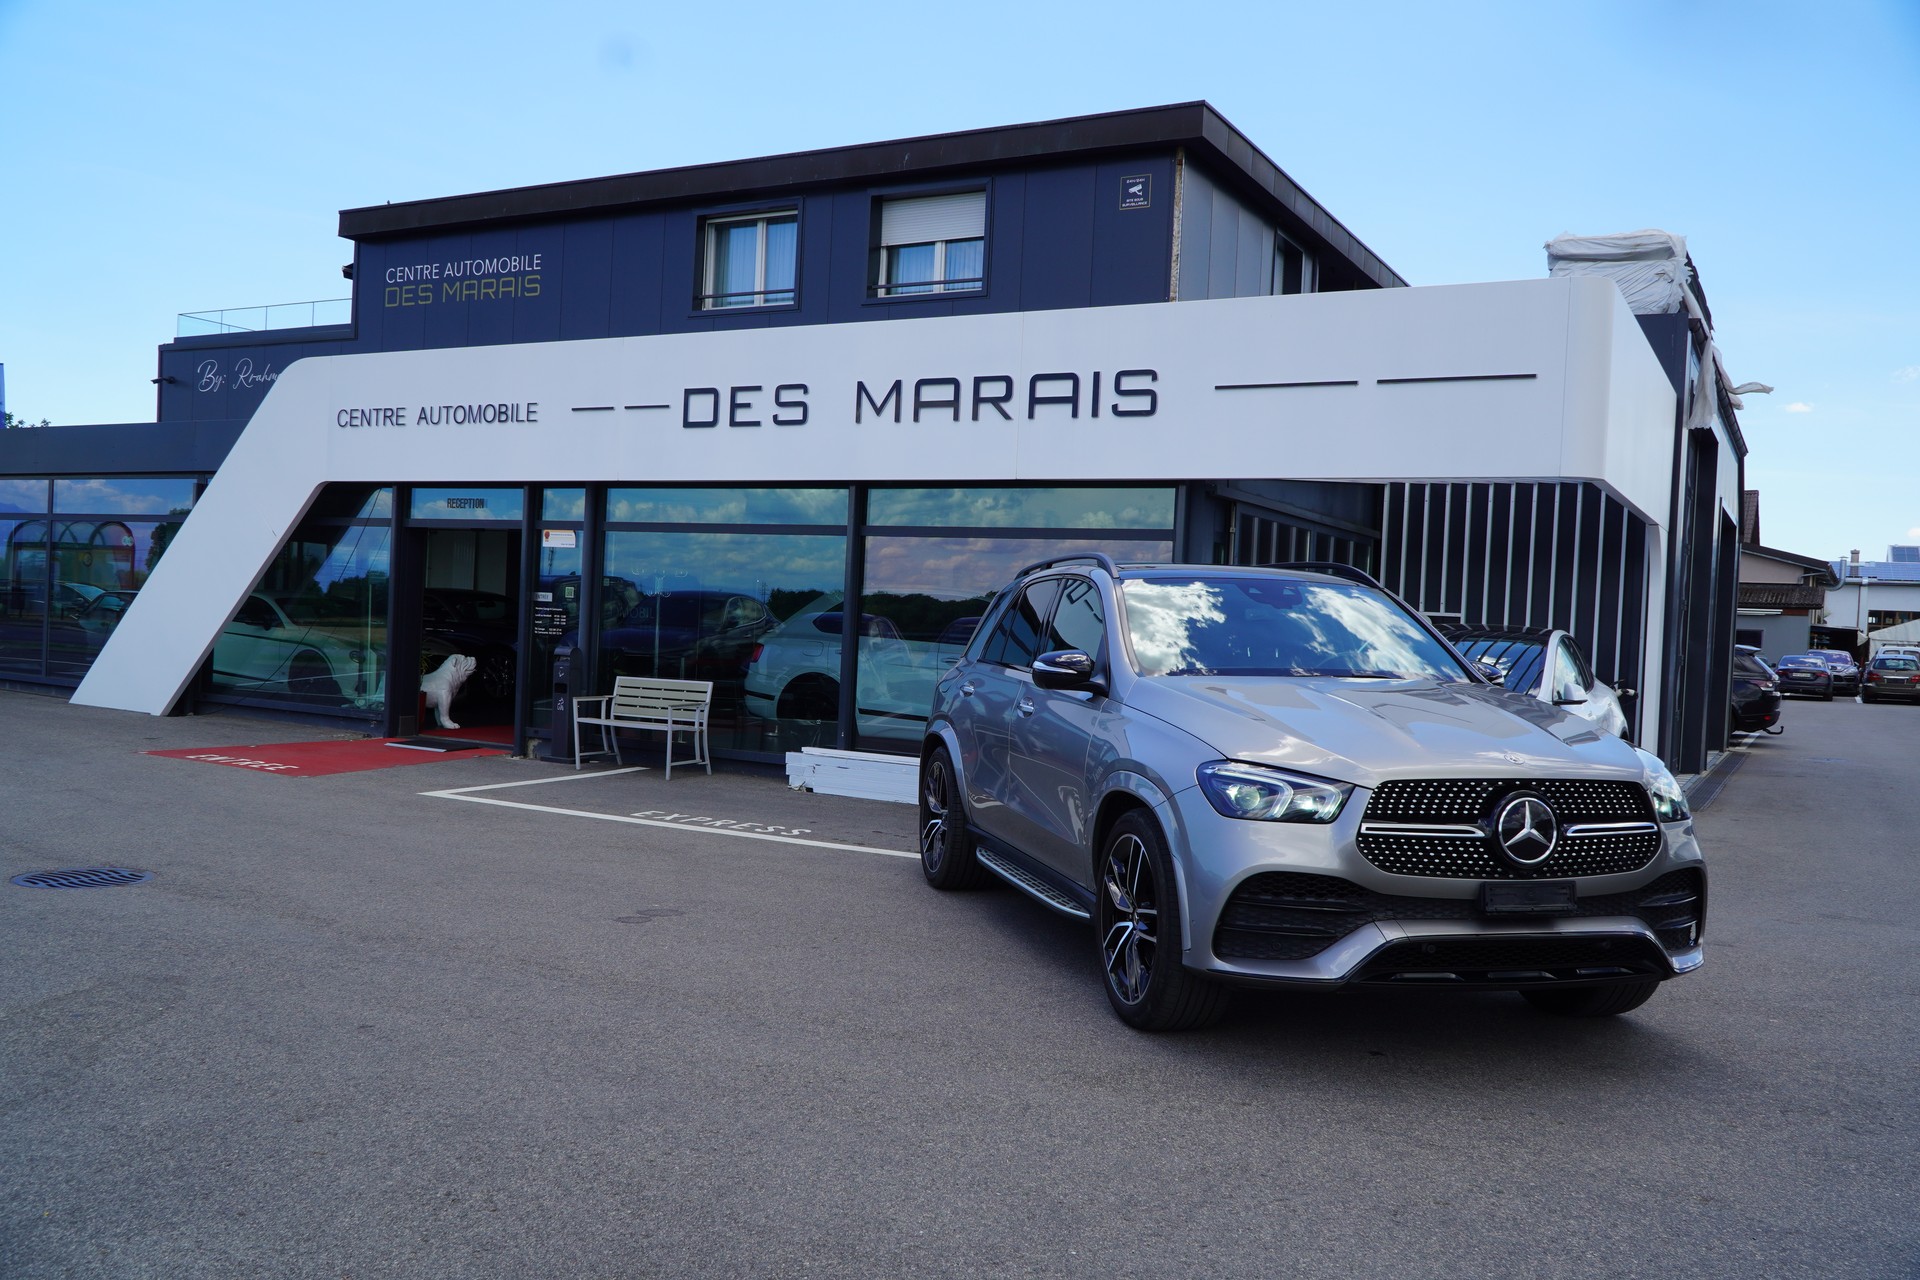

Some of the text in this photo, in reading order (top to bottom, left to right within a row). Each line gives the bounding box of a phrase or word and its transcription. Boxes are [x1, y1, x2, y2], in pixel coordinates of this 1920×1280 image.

[385, 253, 542, 284] CENTRE AUTOMOBILE
[385, 274, 541, 308] DES MARAIS
[197, 359, 227, 393] By:
[337, 368, 1158, 428] CENTRE AUTOMOBILE DES MARAIS
[447, 497, 485, 509] RECEPTION
[629, 810, 812, 836] EXPRESS
